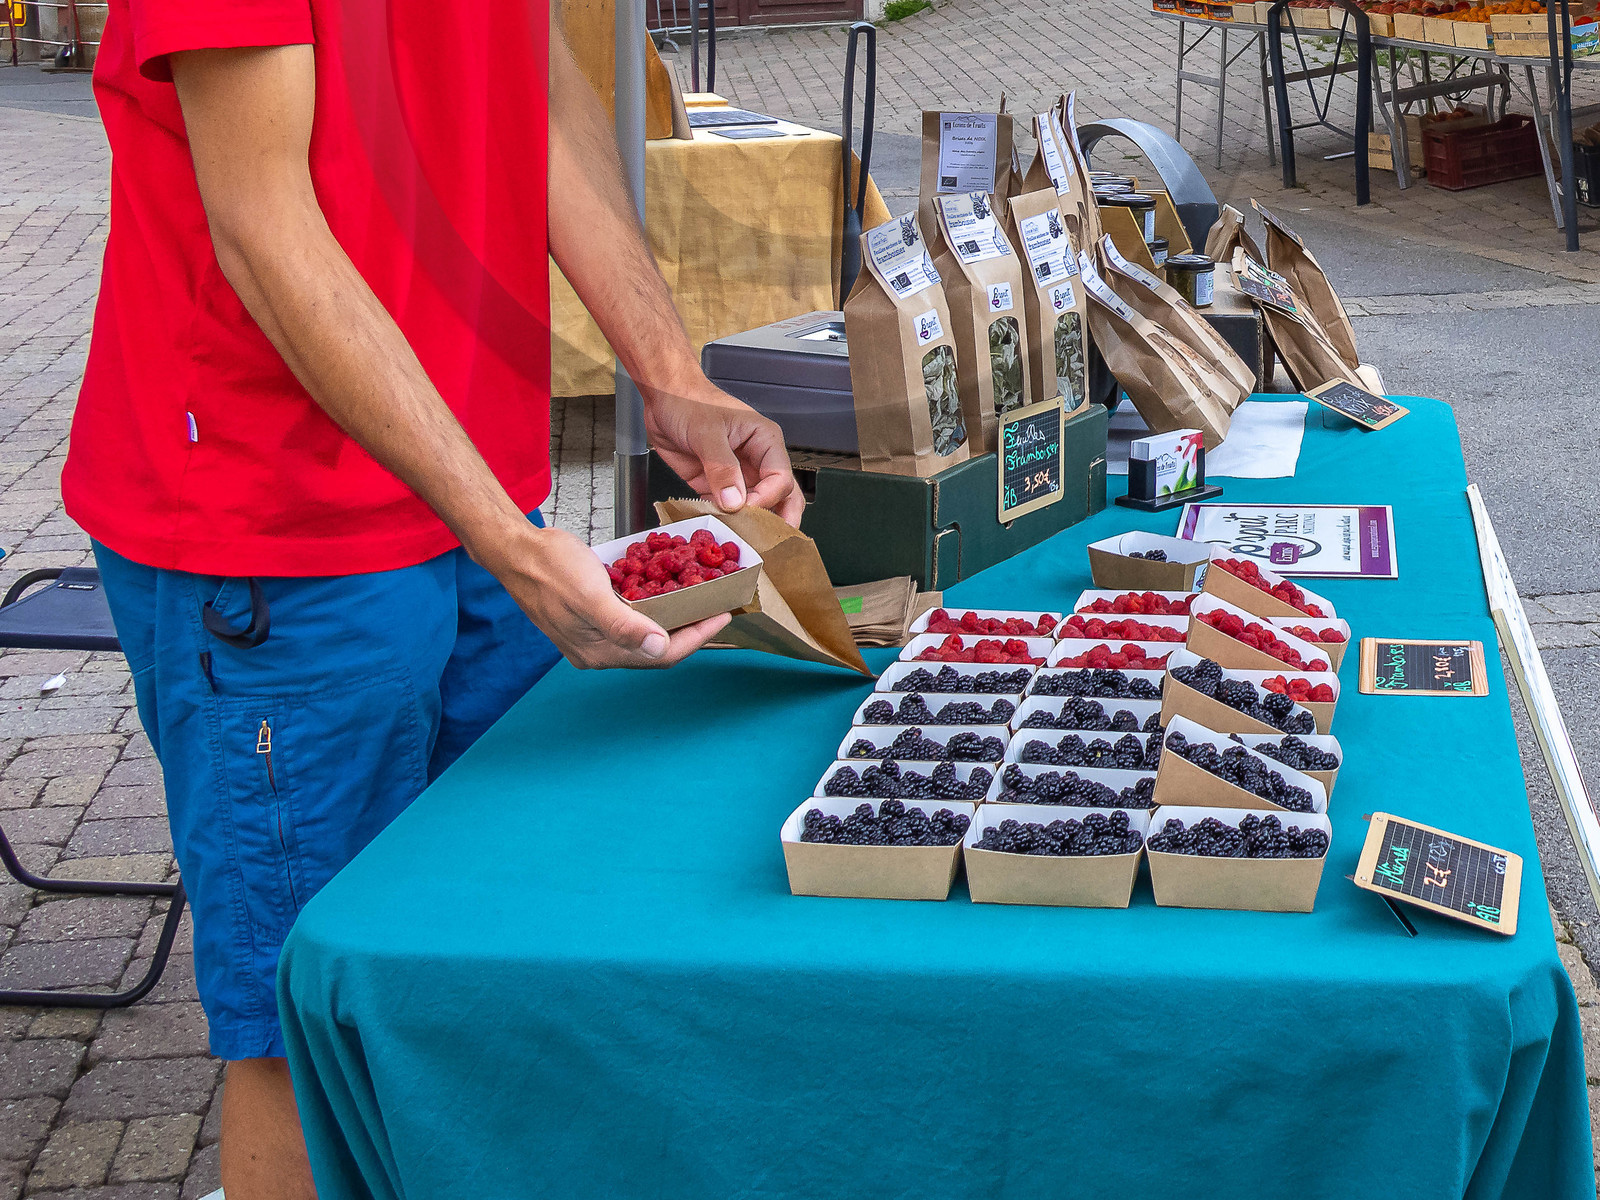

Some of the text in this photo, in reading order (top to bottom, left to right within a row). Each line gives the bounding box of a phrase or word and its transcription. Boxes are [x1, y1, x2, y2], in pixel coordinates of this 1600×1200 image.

[1343, 398, 1374, 416] NOIX
[1024, 468, 1050, 494] 3,50€
[1003, 488, 1018, 511] AB
[1274, 512, 1299, 534] PARC
[1375, 644, 1408, 690] Framboises
[1453, 680, 1472, 692] AB
[1423, 862, 1451, 888] 2€
[1475, 905, 1501, 926] AB
